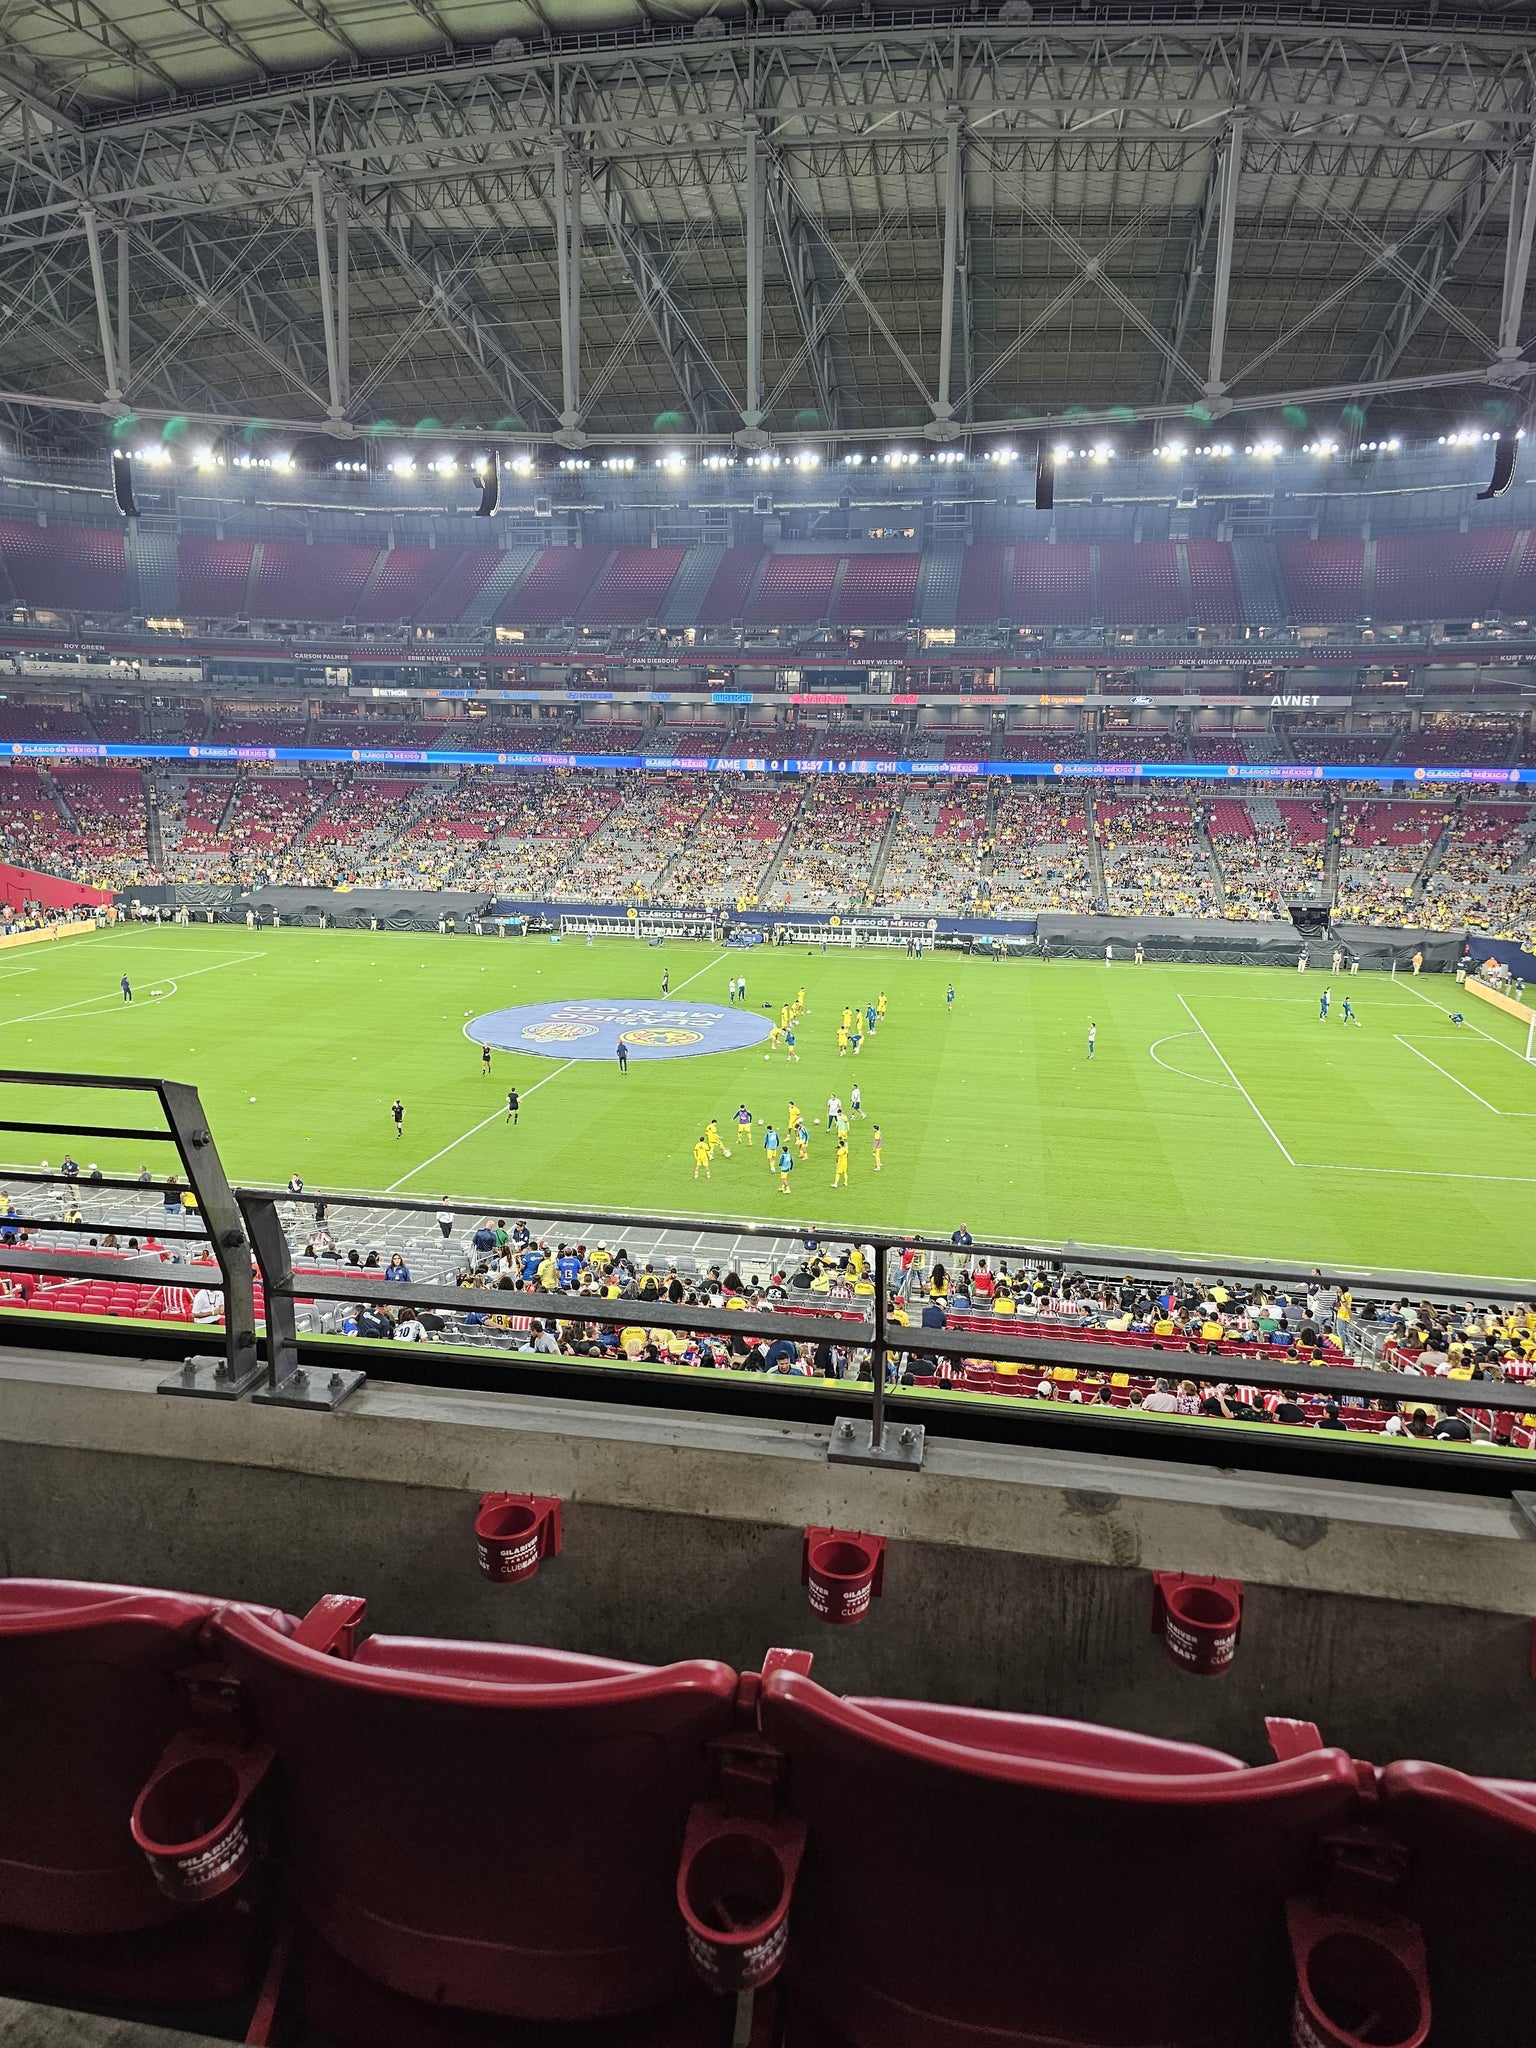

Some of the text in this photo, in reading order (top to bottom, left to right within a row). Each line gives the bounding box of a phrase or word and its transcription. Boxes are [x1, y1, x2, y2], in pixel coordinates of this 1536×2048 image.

[1271, 695, 1320, 706] AVNET
[716, 759, 896, 772] AME 0 13:57 0 CHI
[496, 1315, 504, 1326] 8
[399, 1326, 410, 1338] 10
